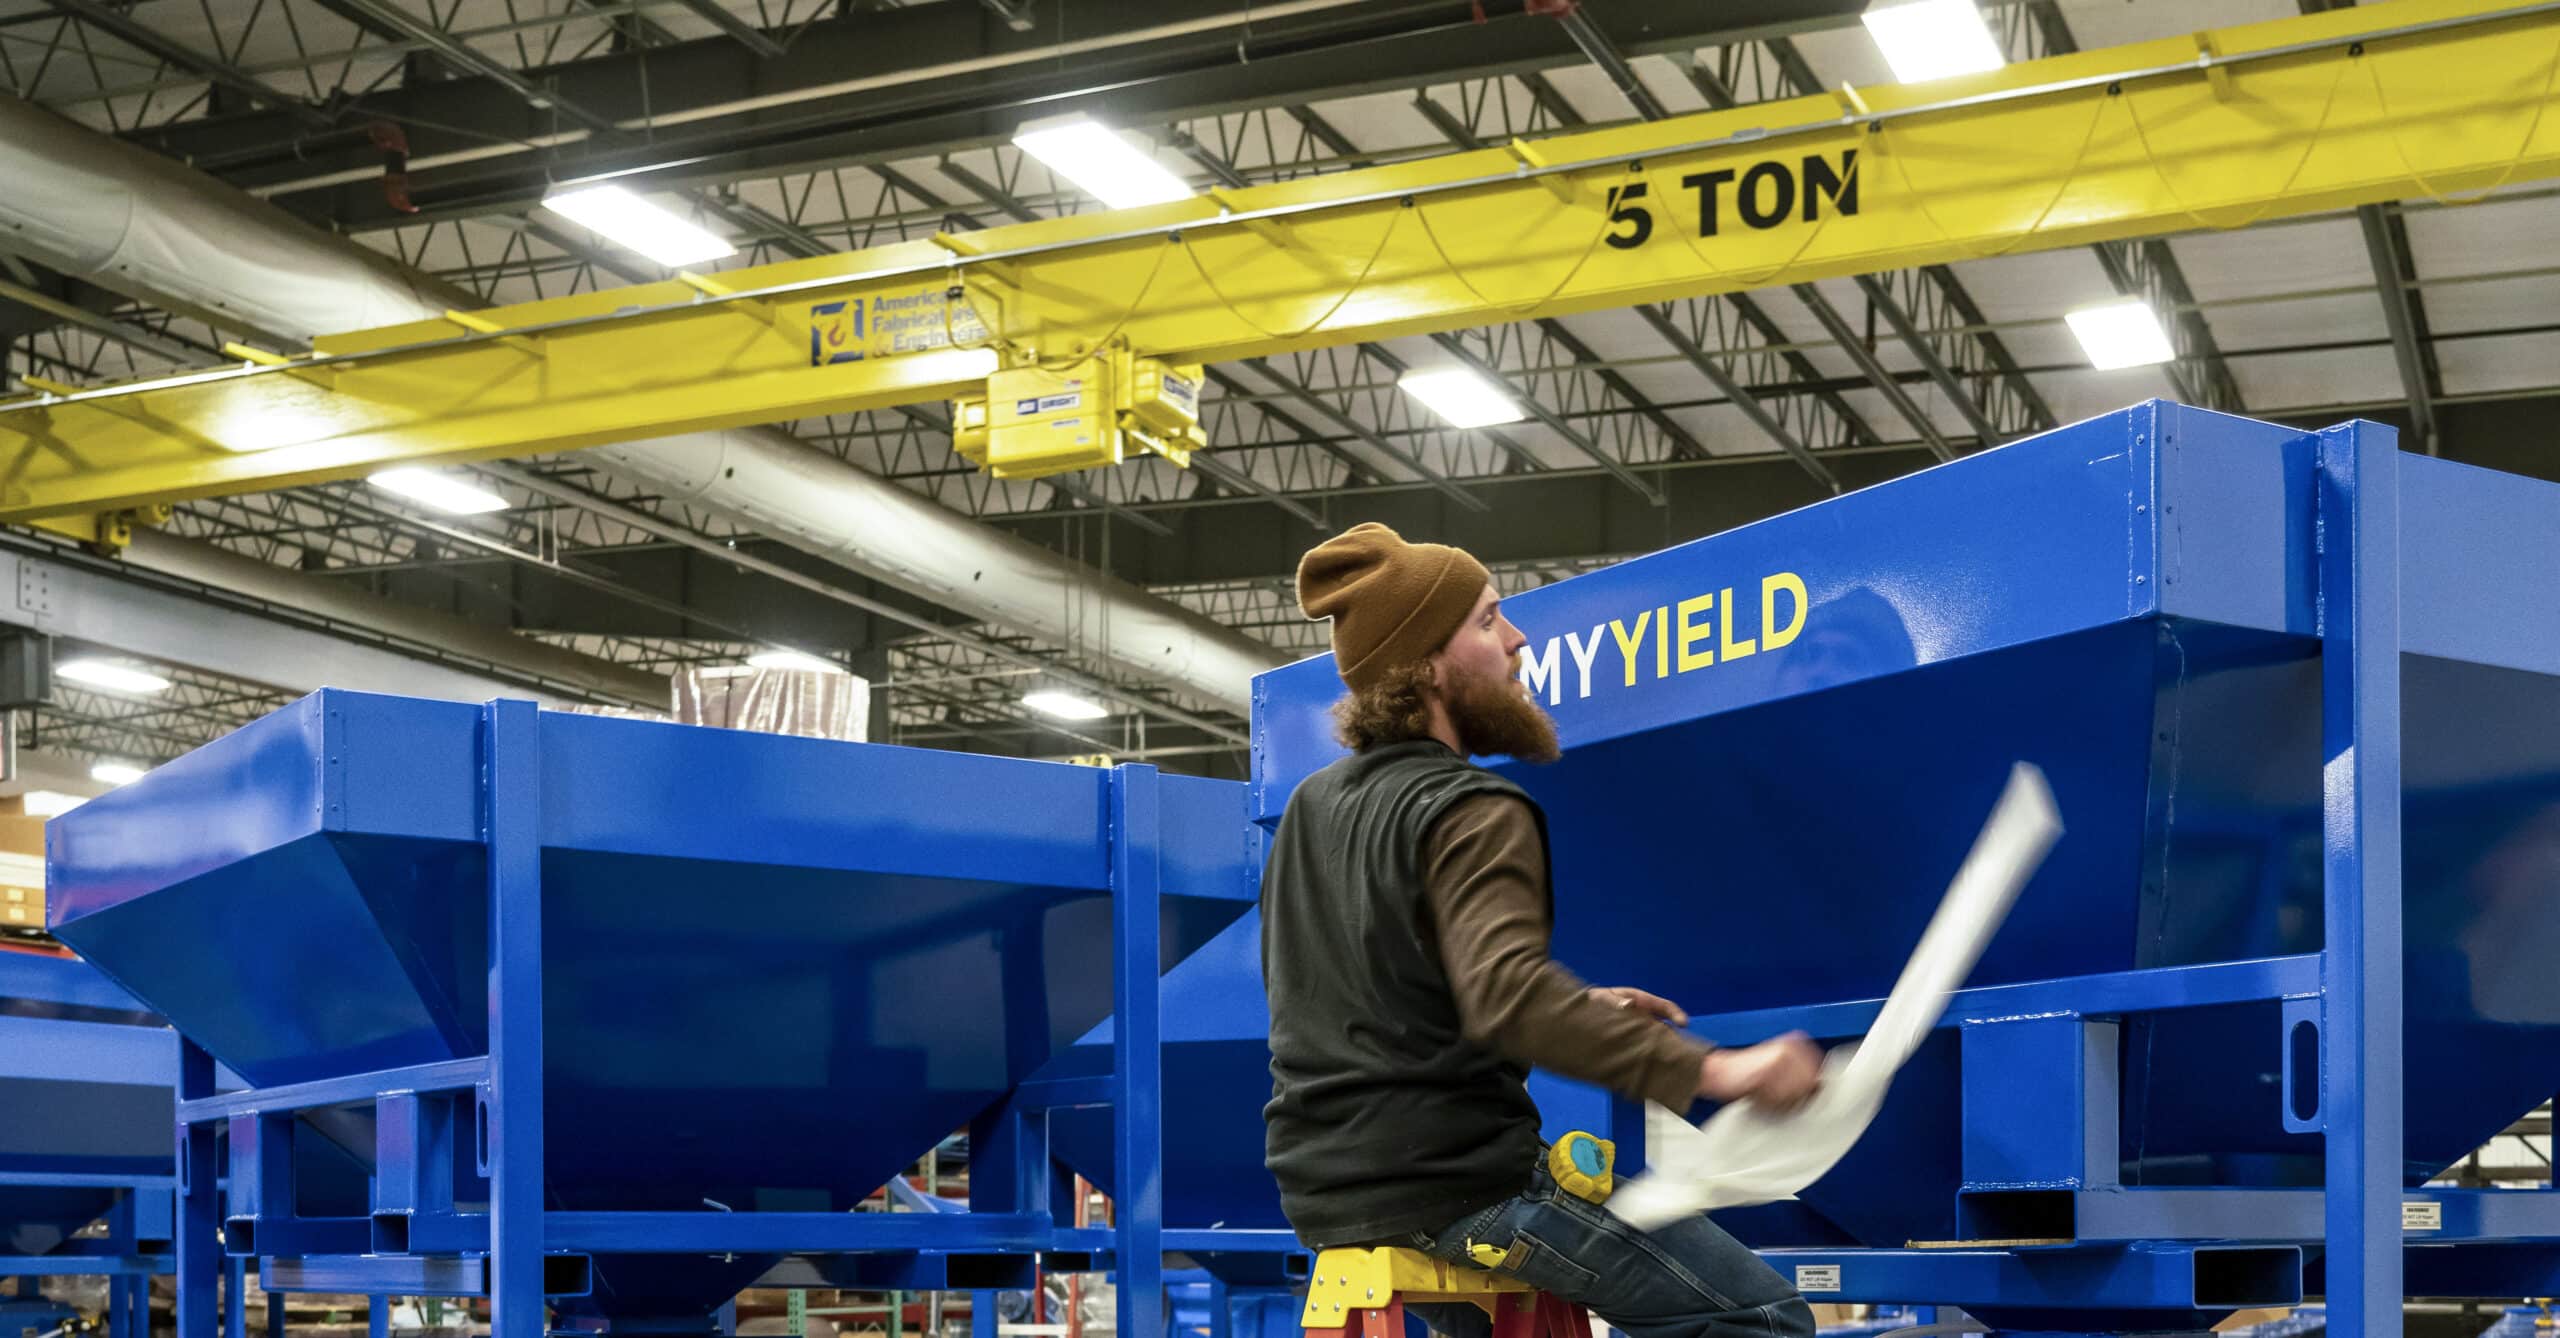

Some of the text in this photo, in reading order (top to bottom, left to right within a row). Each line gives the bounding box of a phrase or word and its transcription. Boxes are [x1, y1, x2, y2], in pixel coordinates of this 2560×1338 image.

[1604, 148, 1859, 250] 5 TON
[872, 288, 961, 312] America
